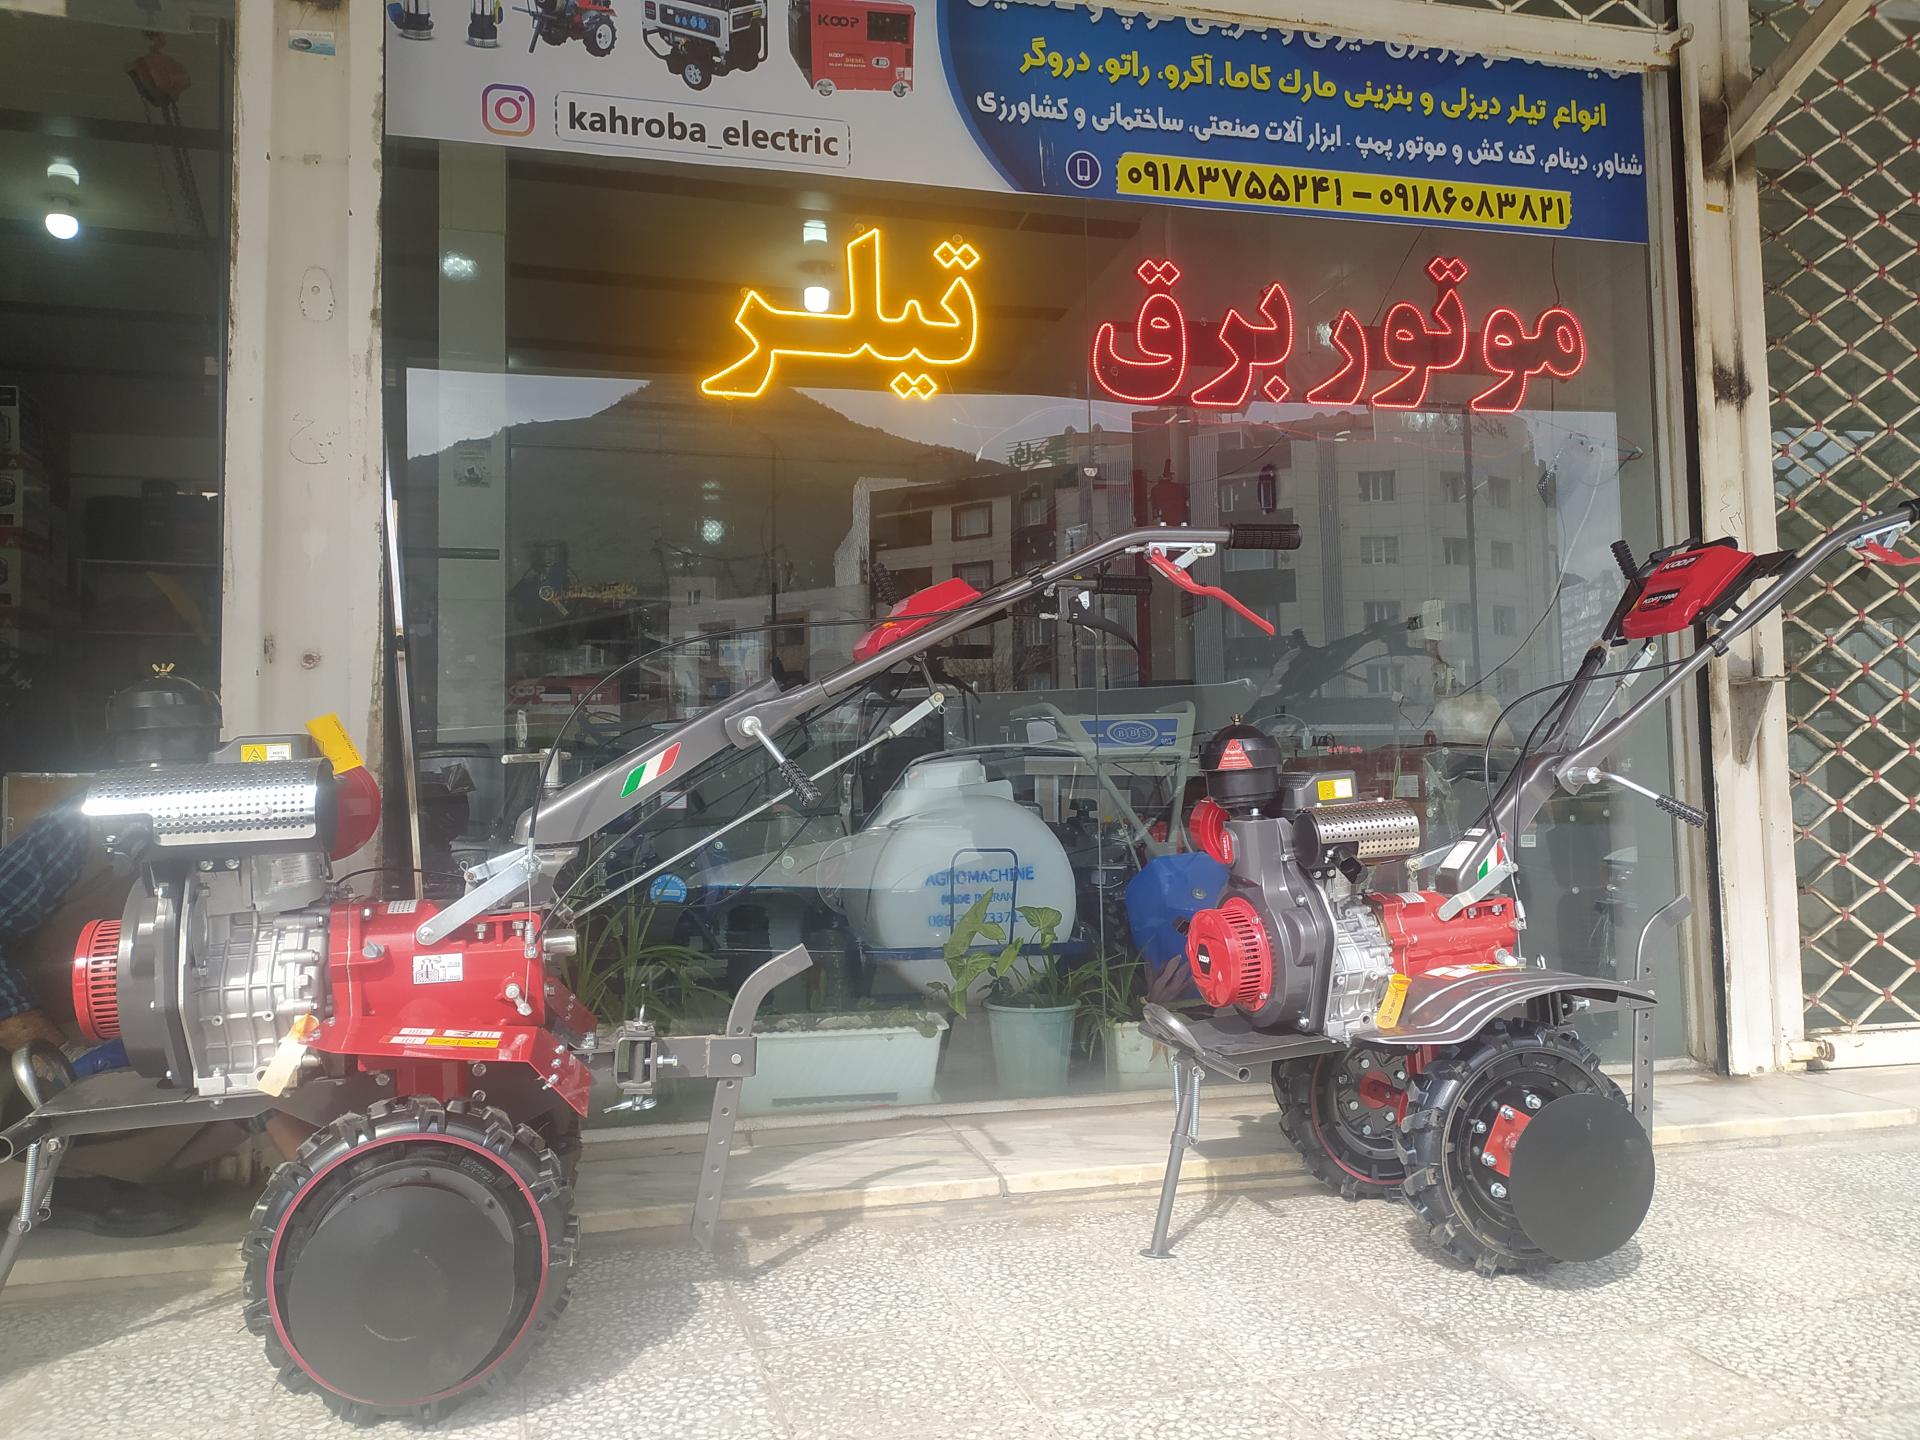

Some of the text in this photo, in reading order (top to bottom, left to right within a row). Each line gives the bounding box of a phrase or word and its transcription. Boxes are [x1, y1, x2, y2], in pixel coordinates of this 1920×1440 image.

[818, 14, 859, 28] KOOP
[1019, 37, 1091, 78] دروگر
[976, 91, 1069, 124] کشاورزی
[1344, 81, 1413, 113] بنزینی
[1419, 92, 1434, 116] و
[1441, 88, 1501, 121] دیزلی
[1507, 95, 1547, 125] تیلر
[568, 101, 839, 156] kahroba_electric
[1073, 106, 1087, 129] و
[1092, 103, 1184, 134] ساختمانی
[1264, 116, 1302, 143] آلات
[1553, 100, 1607, 133] انواع
[1306, 124, 1342, 152] ابزار
[1355, 132, 1393, 160] پمپ
[1396, 136, 1447, 163] موتور
[1467, 139, 1505, 165] کش
[1452, 143, 1464, 164] و
[1508, 145, 1536, 165] کف
[1127, 161, 1342, 205] ۰۹۱۸۳۷۵۵۲۴۱
[1379, 182, 1566, 225] ۰۹۱۸۶۰۸۳۸۲۱
[700, 227, 983, 402] تیلر
[1092, 255, 1588, 413] موتور برق
[1664, 557, 1697, 570] KOOP
[1116, 728, 1149, 738] BBS
[925, 864, 1034, 887] AGROMACHINE
